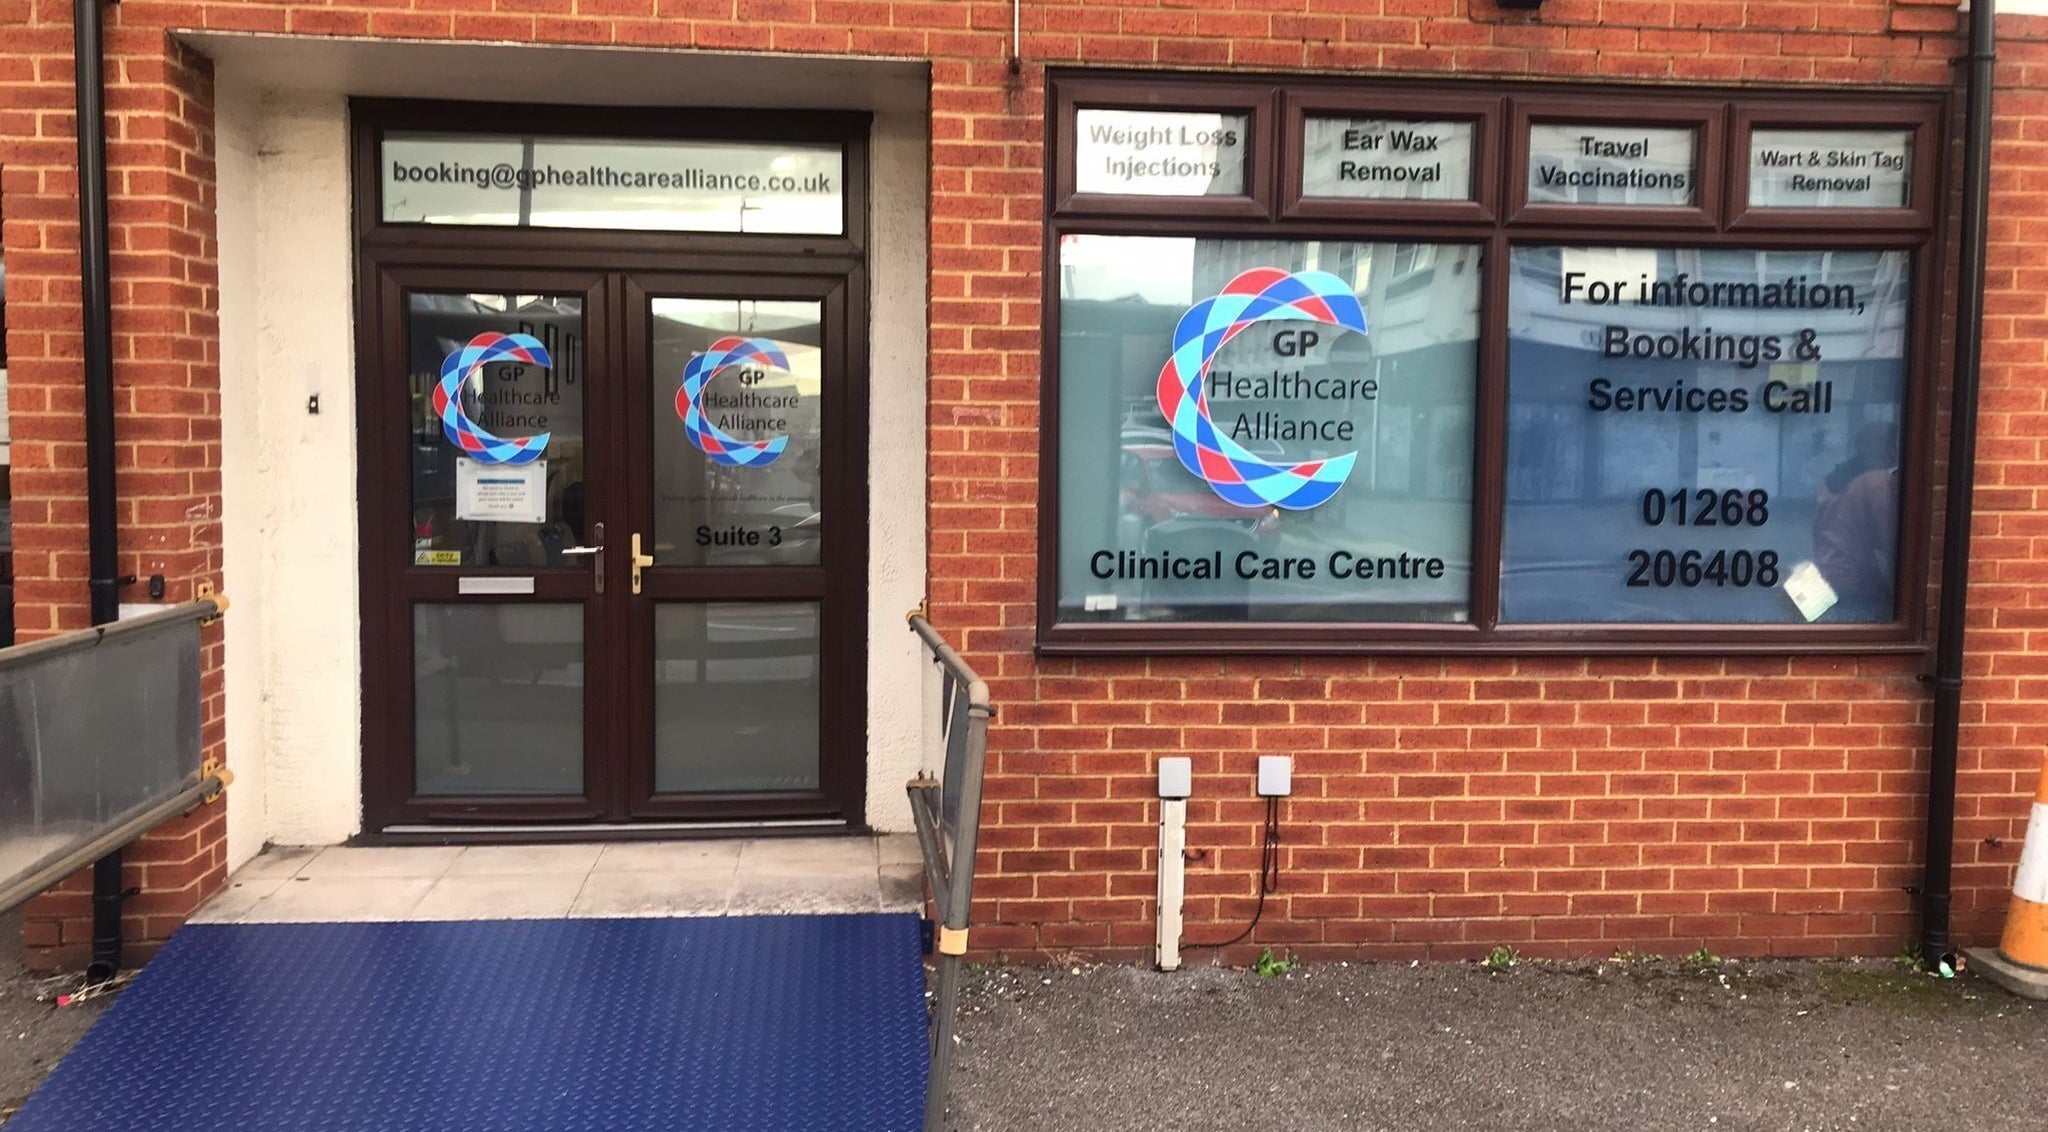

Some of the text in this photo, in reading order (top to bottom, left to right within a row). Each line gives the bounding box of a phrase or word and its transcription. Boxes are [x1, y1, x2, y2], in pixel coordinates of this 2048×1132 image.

[1089, 125, 1238, 150] Weight Loss
[1343, 129, 1438, 152] Ear Wax
[1579, 136, 1649, 158] Travel
[1105, 155, 1221, 180] Injections
[1339, 161, 1441, 183] Removal
[1761, 150, 1904, 171] Wart & Skin Tag
[393, 161, 831, 193] booking@gphealthcarealliance.co.uk
[1540, 166, 1686, 189] Vaccinations
[1791, 174, 1871, 192] Removal
[1562, 271, 1865, 315] For information,
[1272, 329, 1319, 358] GP
[1603, 325, 1822, 369] Bookings &
[498, 366, 525, 382] GP
[739, 369, 765, 385] GP
[1210, 370, 1378, 401] Healthcare
[464, 388, 560, 406] Healthcare
[705, 391, 799, 409] Healthcare
[1587, 377, 1833, 415] Services Call
[478, 410, 548, 428] Alliance
[718, 414, 787, 431] Alliance
[1231, 412, 1354, 442] Alliance
[1642, 487, 1770, 527] 01268
[696, 525, 783, 546] Suite 3
[1090, 550, 1445, 580] Clinical Care Centre
[1625, 548, 1780, 588] 206408
